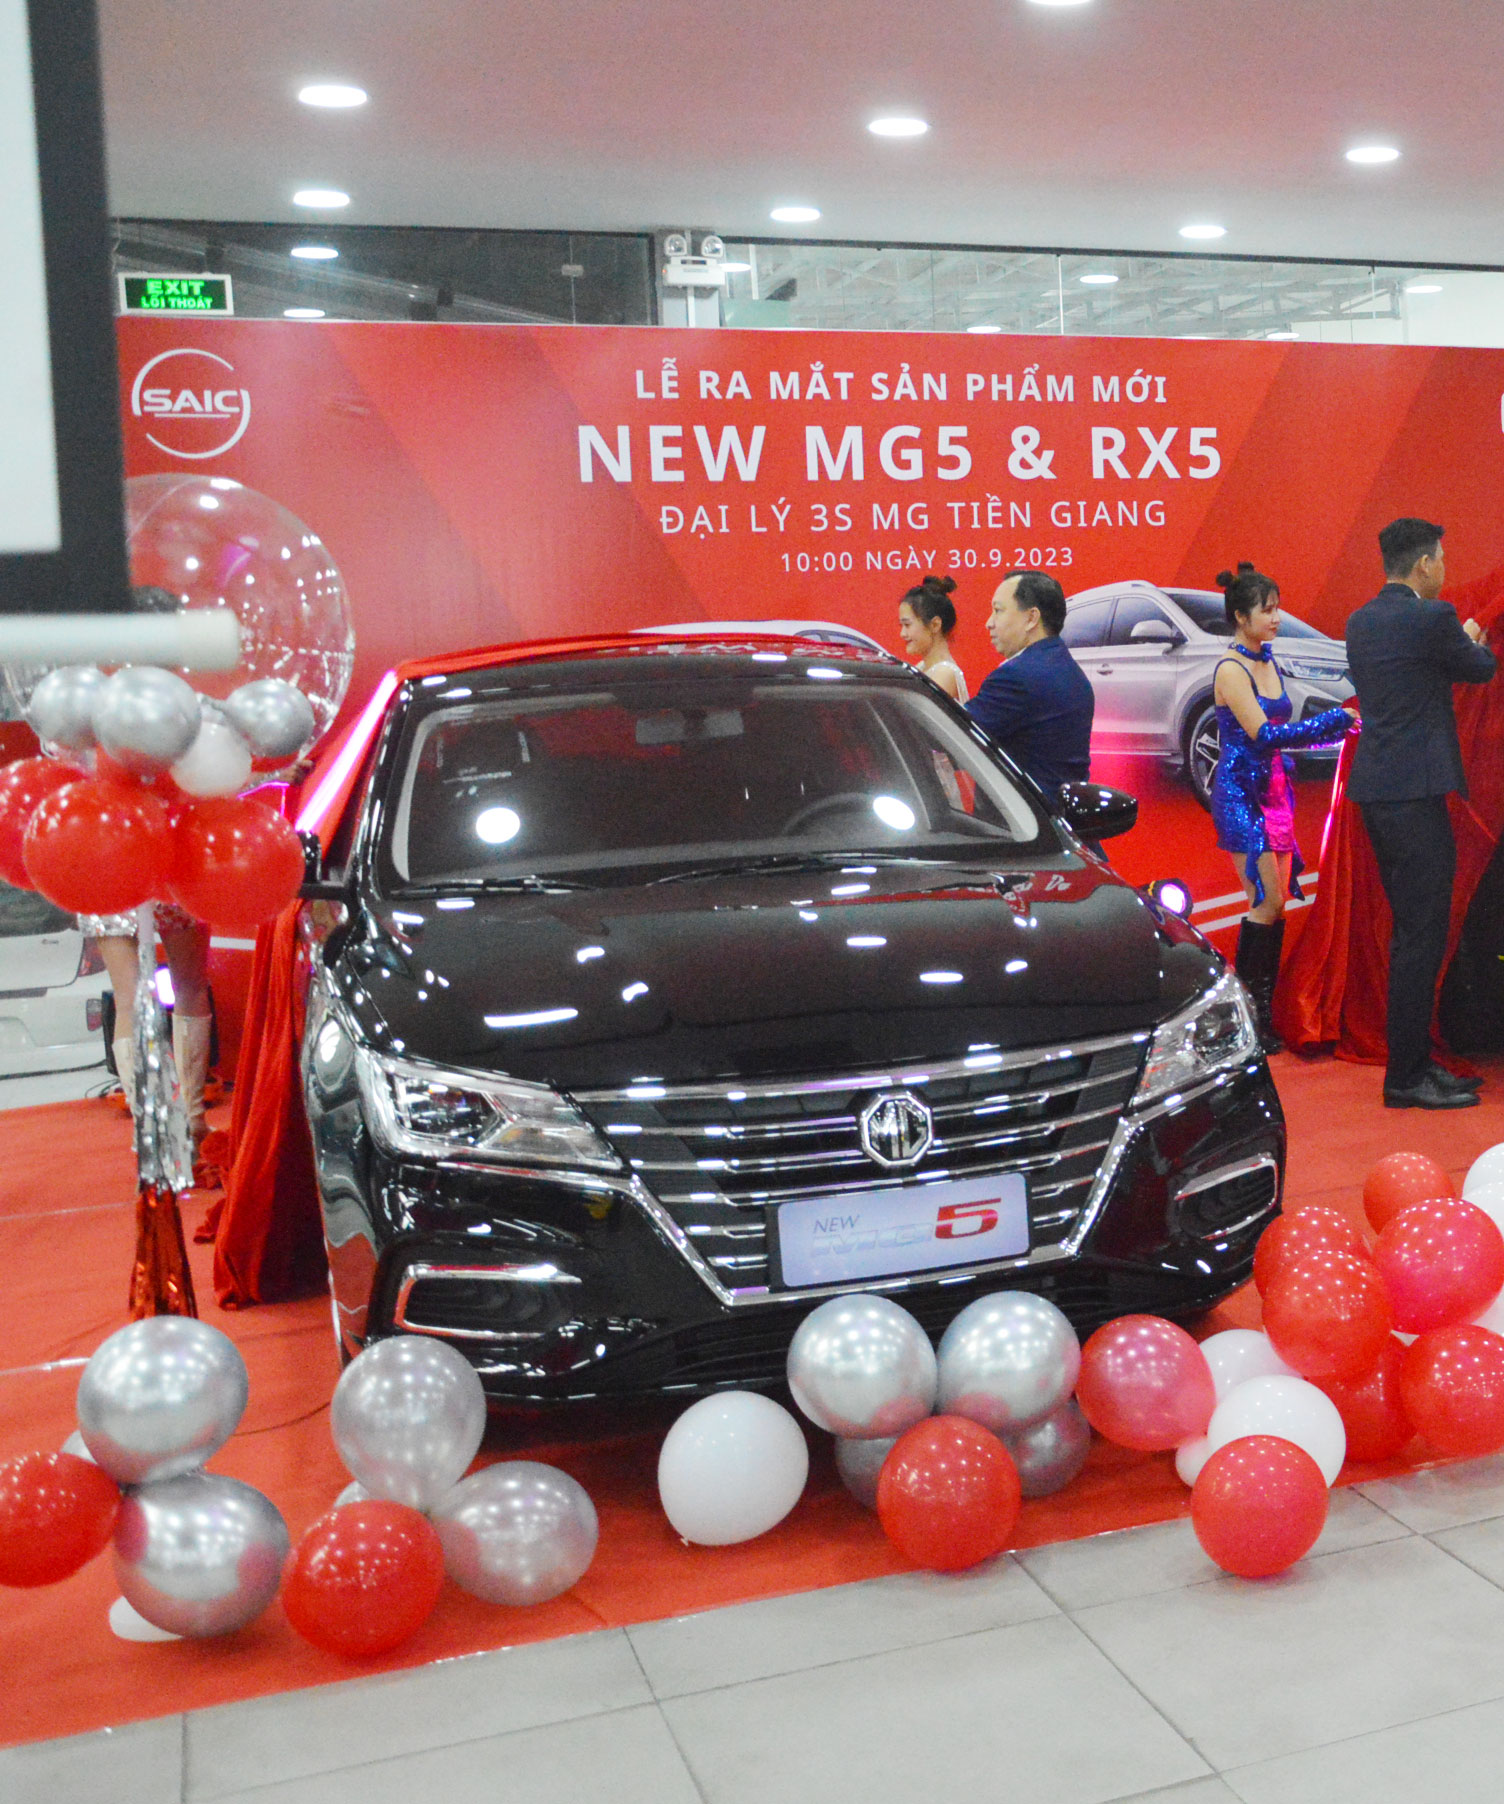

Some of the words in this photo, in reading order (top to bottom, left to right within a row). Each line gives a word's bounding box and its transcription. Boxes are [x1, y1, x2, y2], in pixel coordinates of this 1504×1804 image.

[146, 278, 205, 296] EXIT
[635, 356, 680, 399] LỄ
[699, 370, 752, 400] RA
[769, 360, 855, 401] MẮT
[871, 362, 947, 401] SẢN
[966, 364, 1075, 402] PHẨM
[1092, 368, 1167, 403] MỚI
[142, 389, 240, 413] SAIC
[577, 424, 767, 483] NEW
[805, 424, 972, 481] MG5
[1007, 425, 1057, 480] &
[1091, 426, 1221, 480] RX5
[659, 505, 730, 539] ĐẠI
[750, 496, 791, 533] LÝ
[810, 503, 853, 532] 3S
[872, 502, 929, 530] MG
[946, 493, 1031, 529] TIỀN
[1050, 500, 1165, 528] GIANG
[781, 551, 853, 572] 10:00
[866, 545, 937, 570] NGÀY
[948, 547, 1073, 569] 30.9.2023
[867, 1098, 928, 1161] MG
[812, 1214, 860, 1234] NEW
